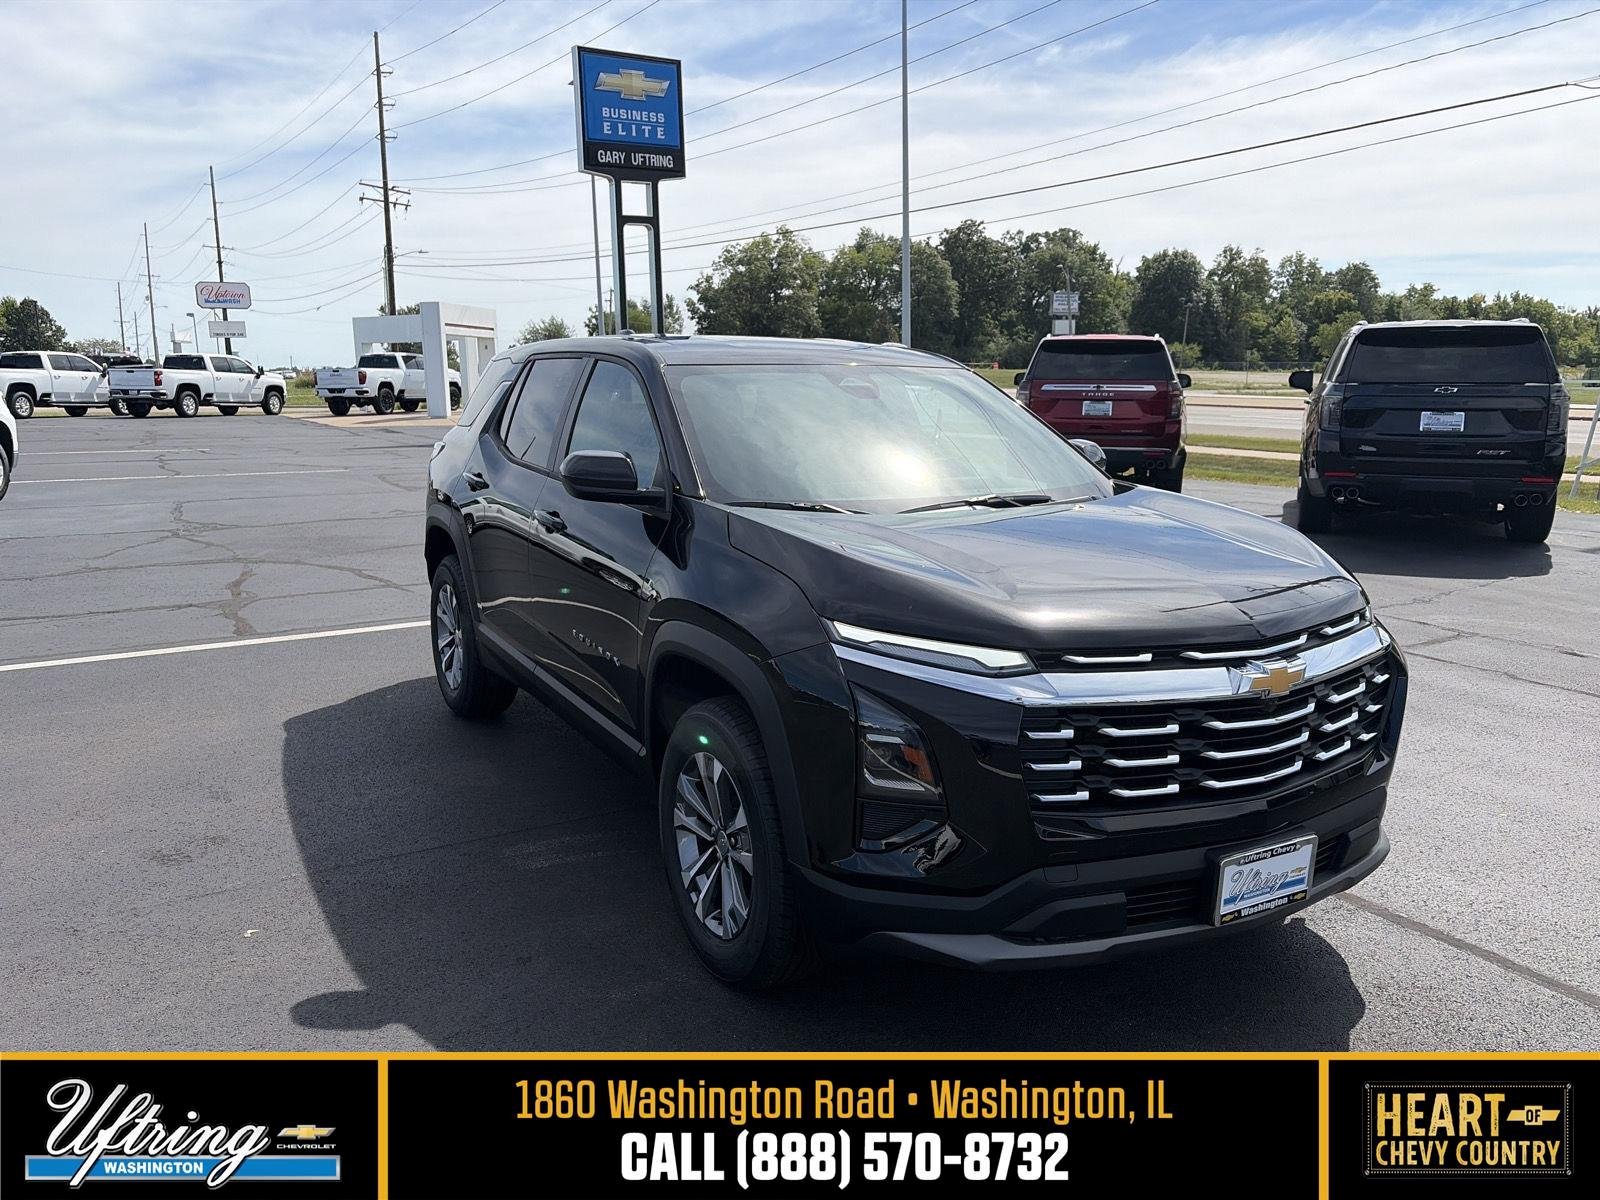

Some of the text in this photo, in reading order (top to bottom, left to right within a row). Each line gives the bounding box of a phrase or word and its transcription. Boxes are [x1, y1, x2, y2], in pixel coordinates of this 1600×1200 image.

[602, 107, 665, 123] BUSINESS
[603, 122, 665, 139] ELITE
[597, 150, 674, 168] GARY UFTRING
[200, 285, 245, 300] Uptown
[1245, 844, 1296, 863] Uftring Chevy
[1241, 897, 1288, 917] Washington
